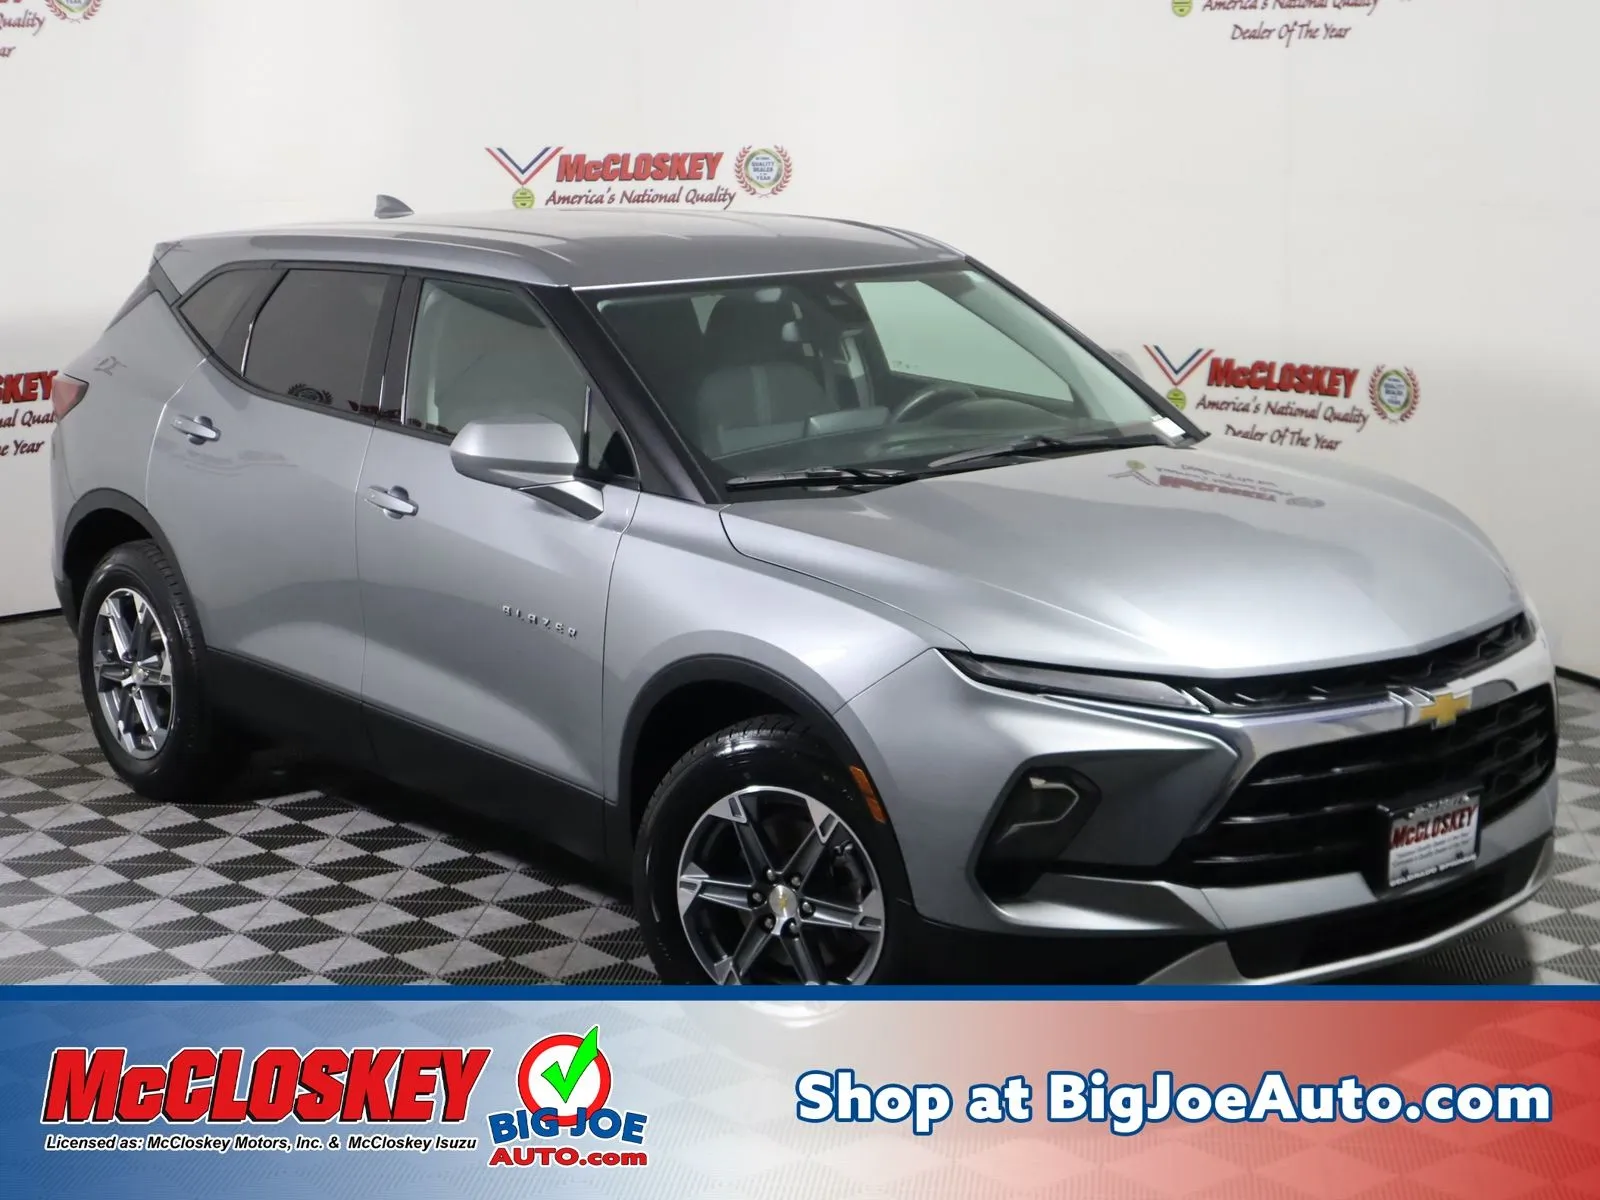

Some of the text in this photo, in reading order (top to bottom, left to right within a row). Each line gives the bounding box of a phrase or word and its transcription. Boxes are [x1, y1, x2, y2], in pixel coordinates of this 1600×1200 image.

[1231, 20, 1352, 48] Dealer Of The Year
[556, 152, 724, 182] McCLOSKEY
[545, 185, 736, 210] America's National Quality
[1207, 357, 1360, 399] McCLOSKEY
[1195, 394, 1370, 433] America's National Quality
[13, 439, 45, 456] Year
[1289, 429, 1311, 447] The
[1314, 433, 1342, 450] Year
